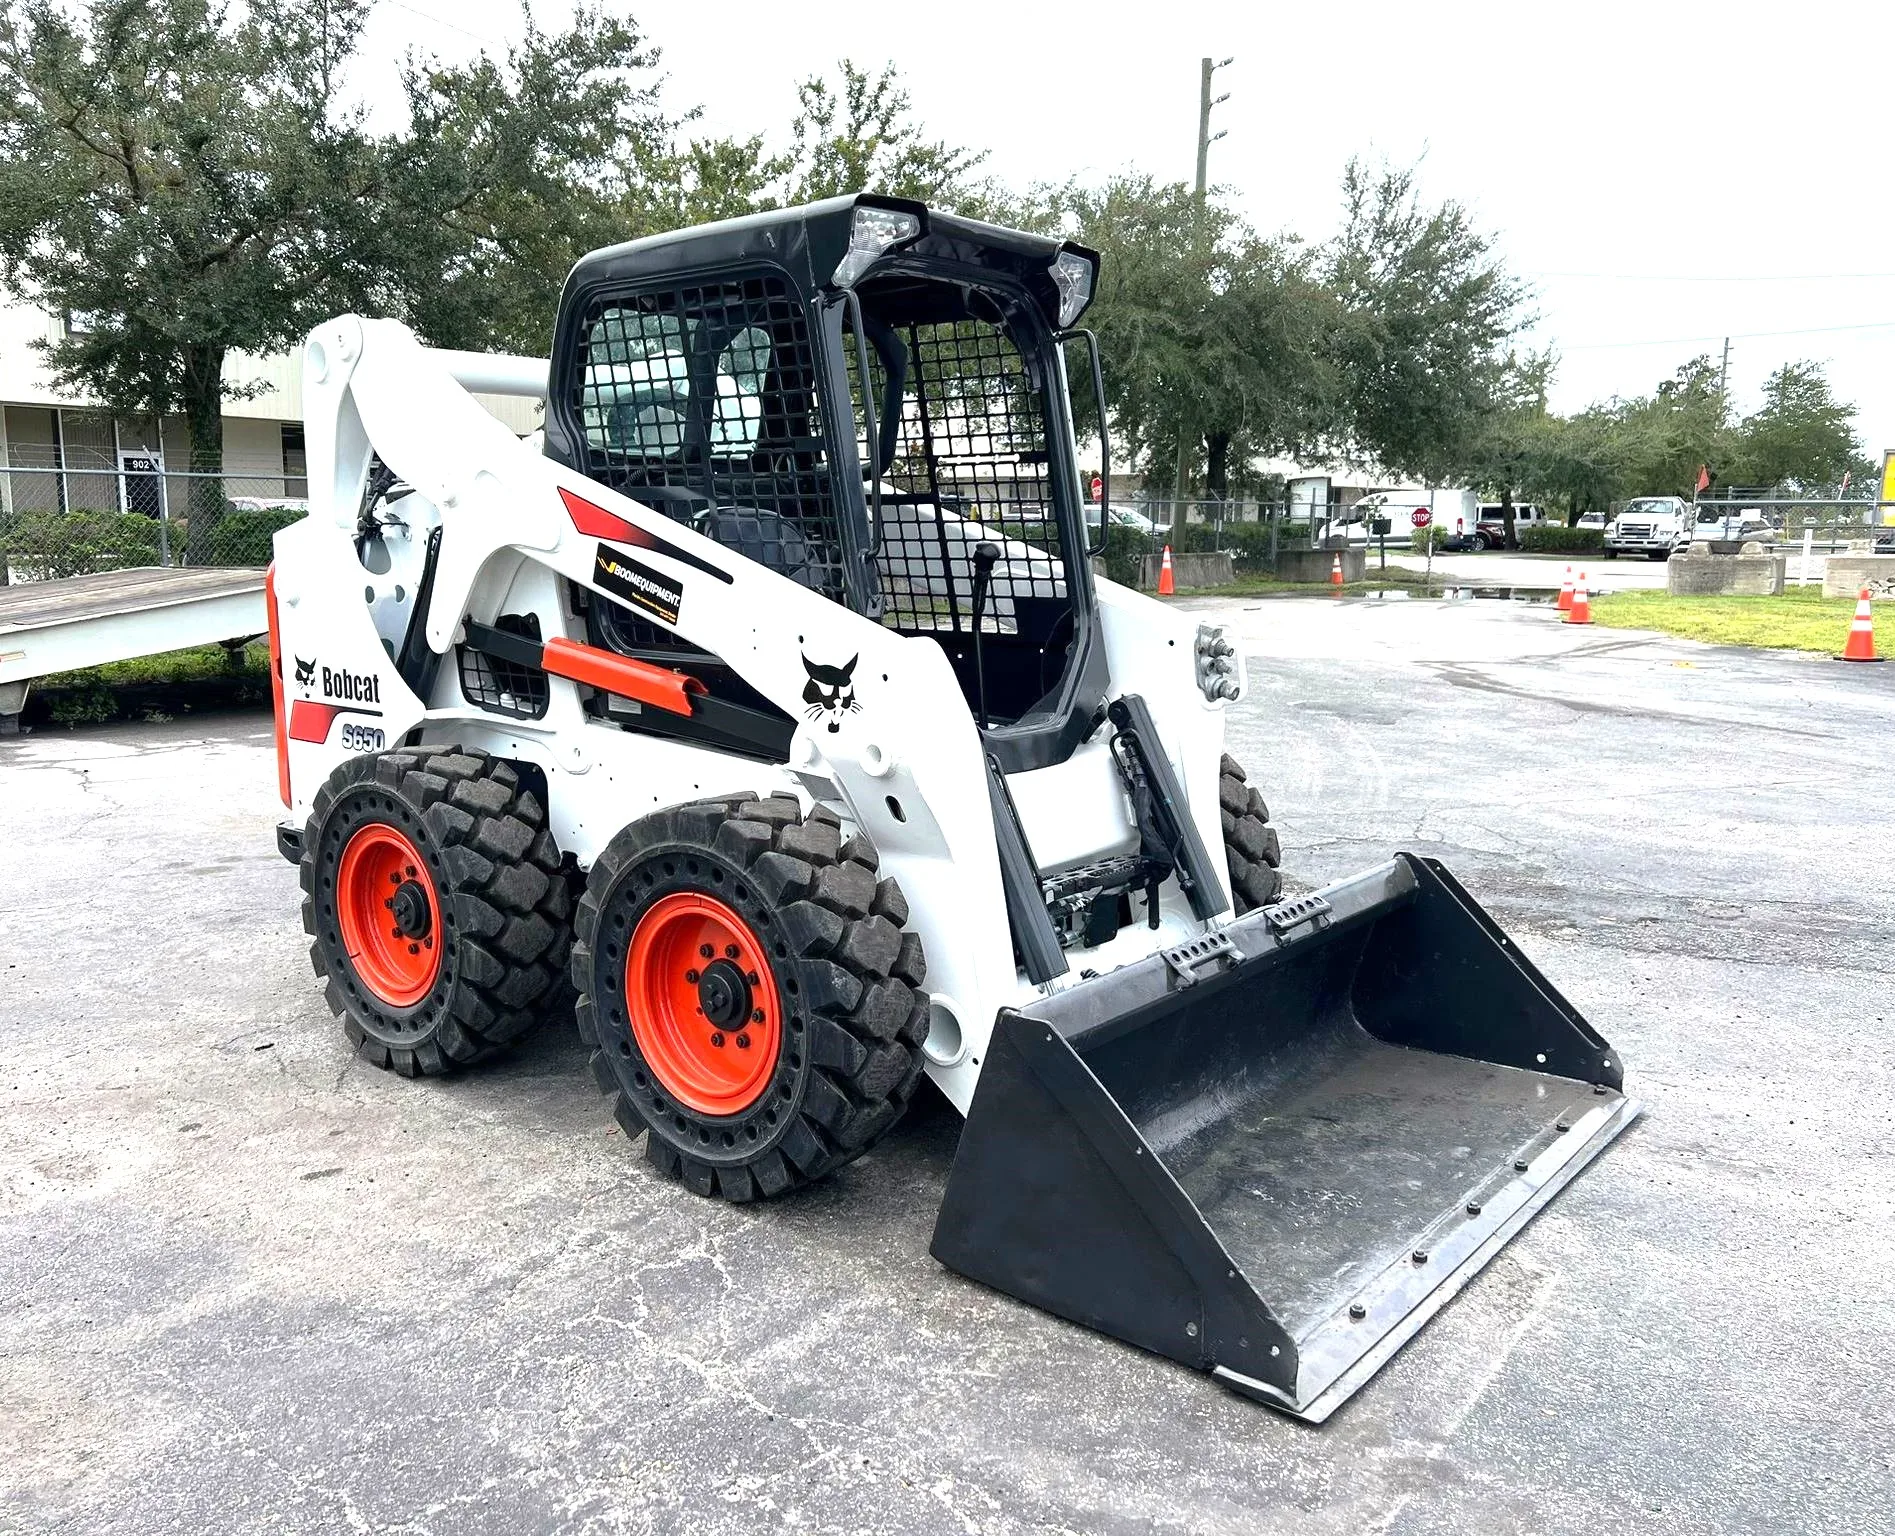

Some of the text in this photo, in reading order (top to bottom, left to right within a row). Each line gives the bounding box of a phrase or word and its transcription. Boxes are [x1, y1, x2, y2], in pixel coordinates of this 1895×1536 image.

[132, 460, 150, 468] 902
[1412, 514, 1430, 522] STOP
[322, 666, 380, 703] Bobcat
[342, 723, 385, 753] S650
